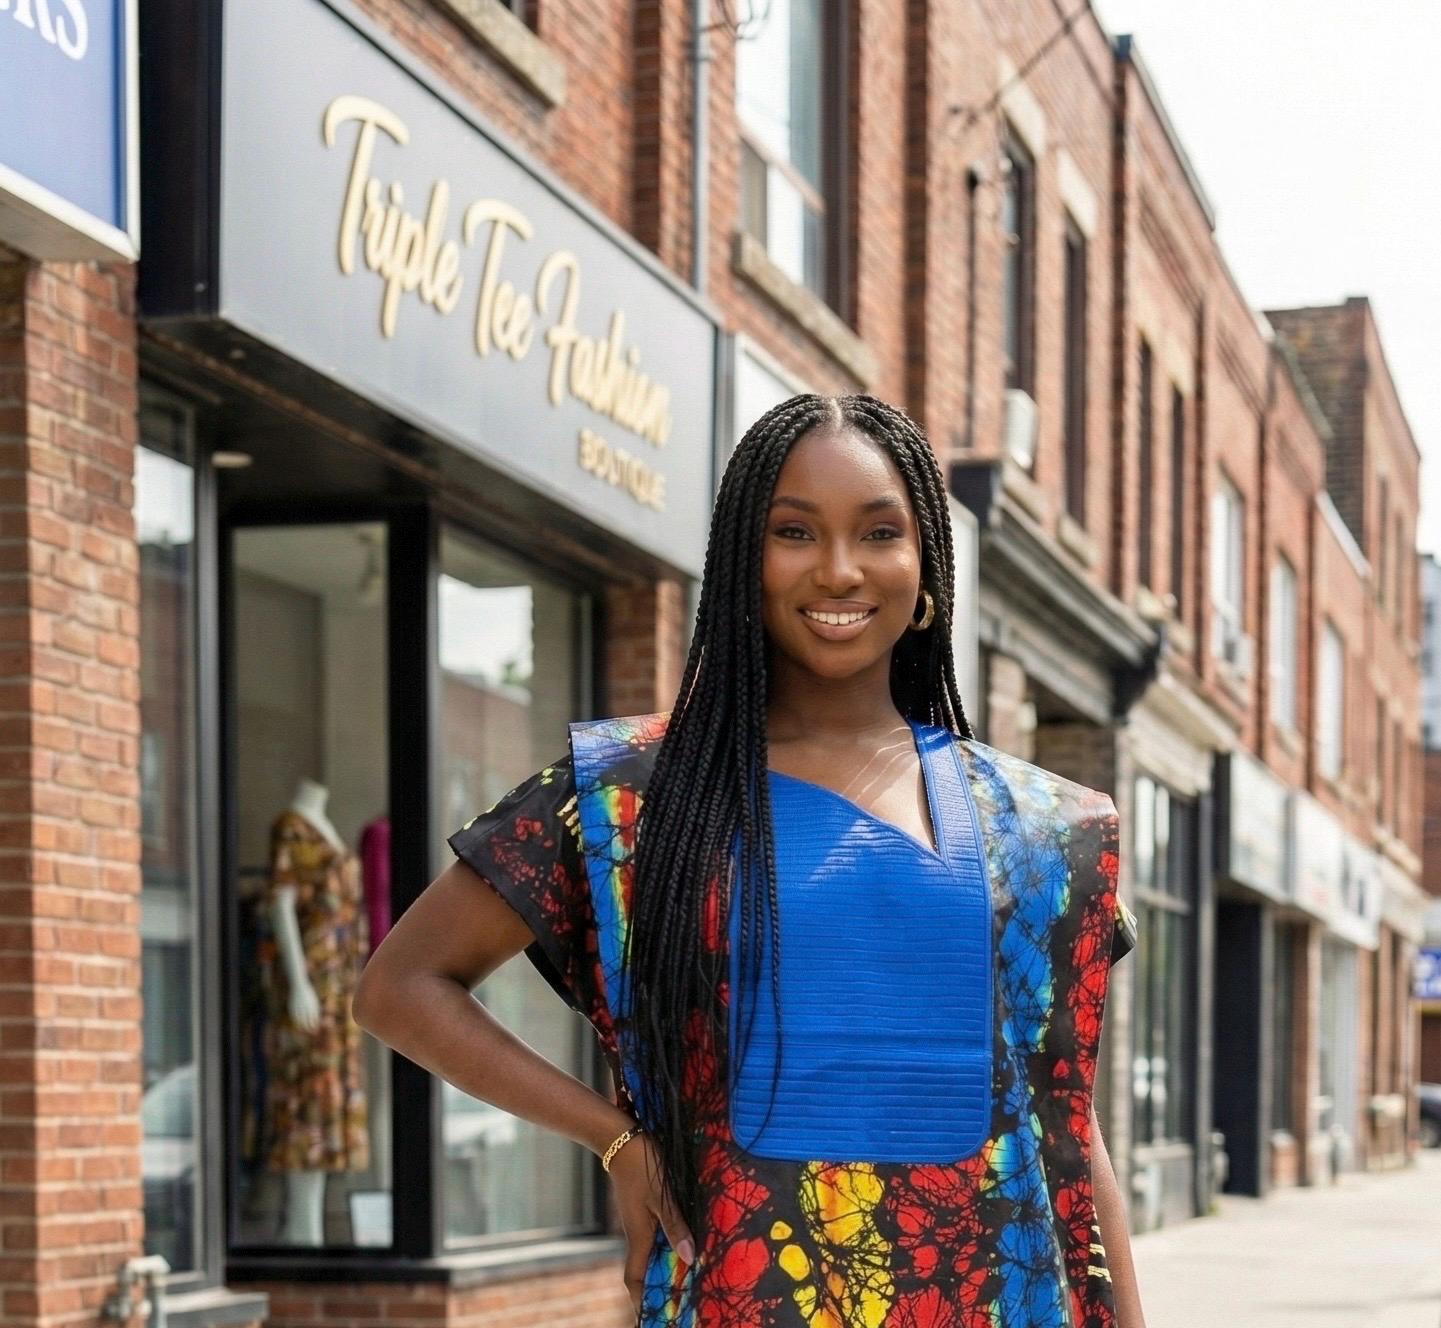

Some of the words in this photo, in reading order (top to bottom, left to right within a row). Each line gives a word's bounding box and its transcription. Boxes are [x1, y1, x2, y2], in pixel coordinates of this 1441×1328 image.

[323, 96, 463, 340] Triple
[463, 199, 534, 361] Tee
[536, 250, 671, 448] Fashion
[579, 428, 666, 511] BOUTIQUE
